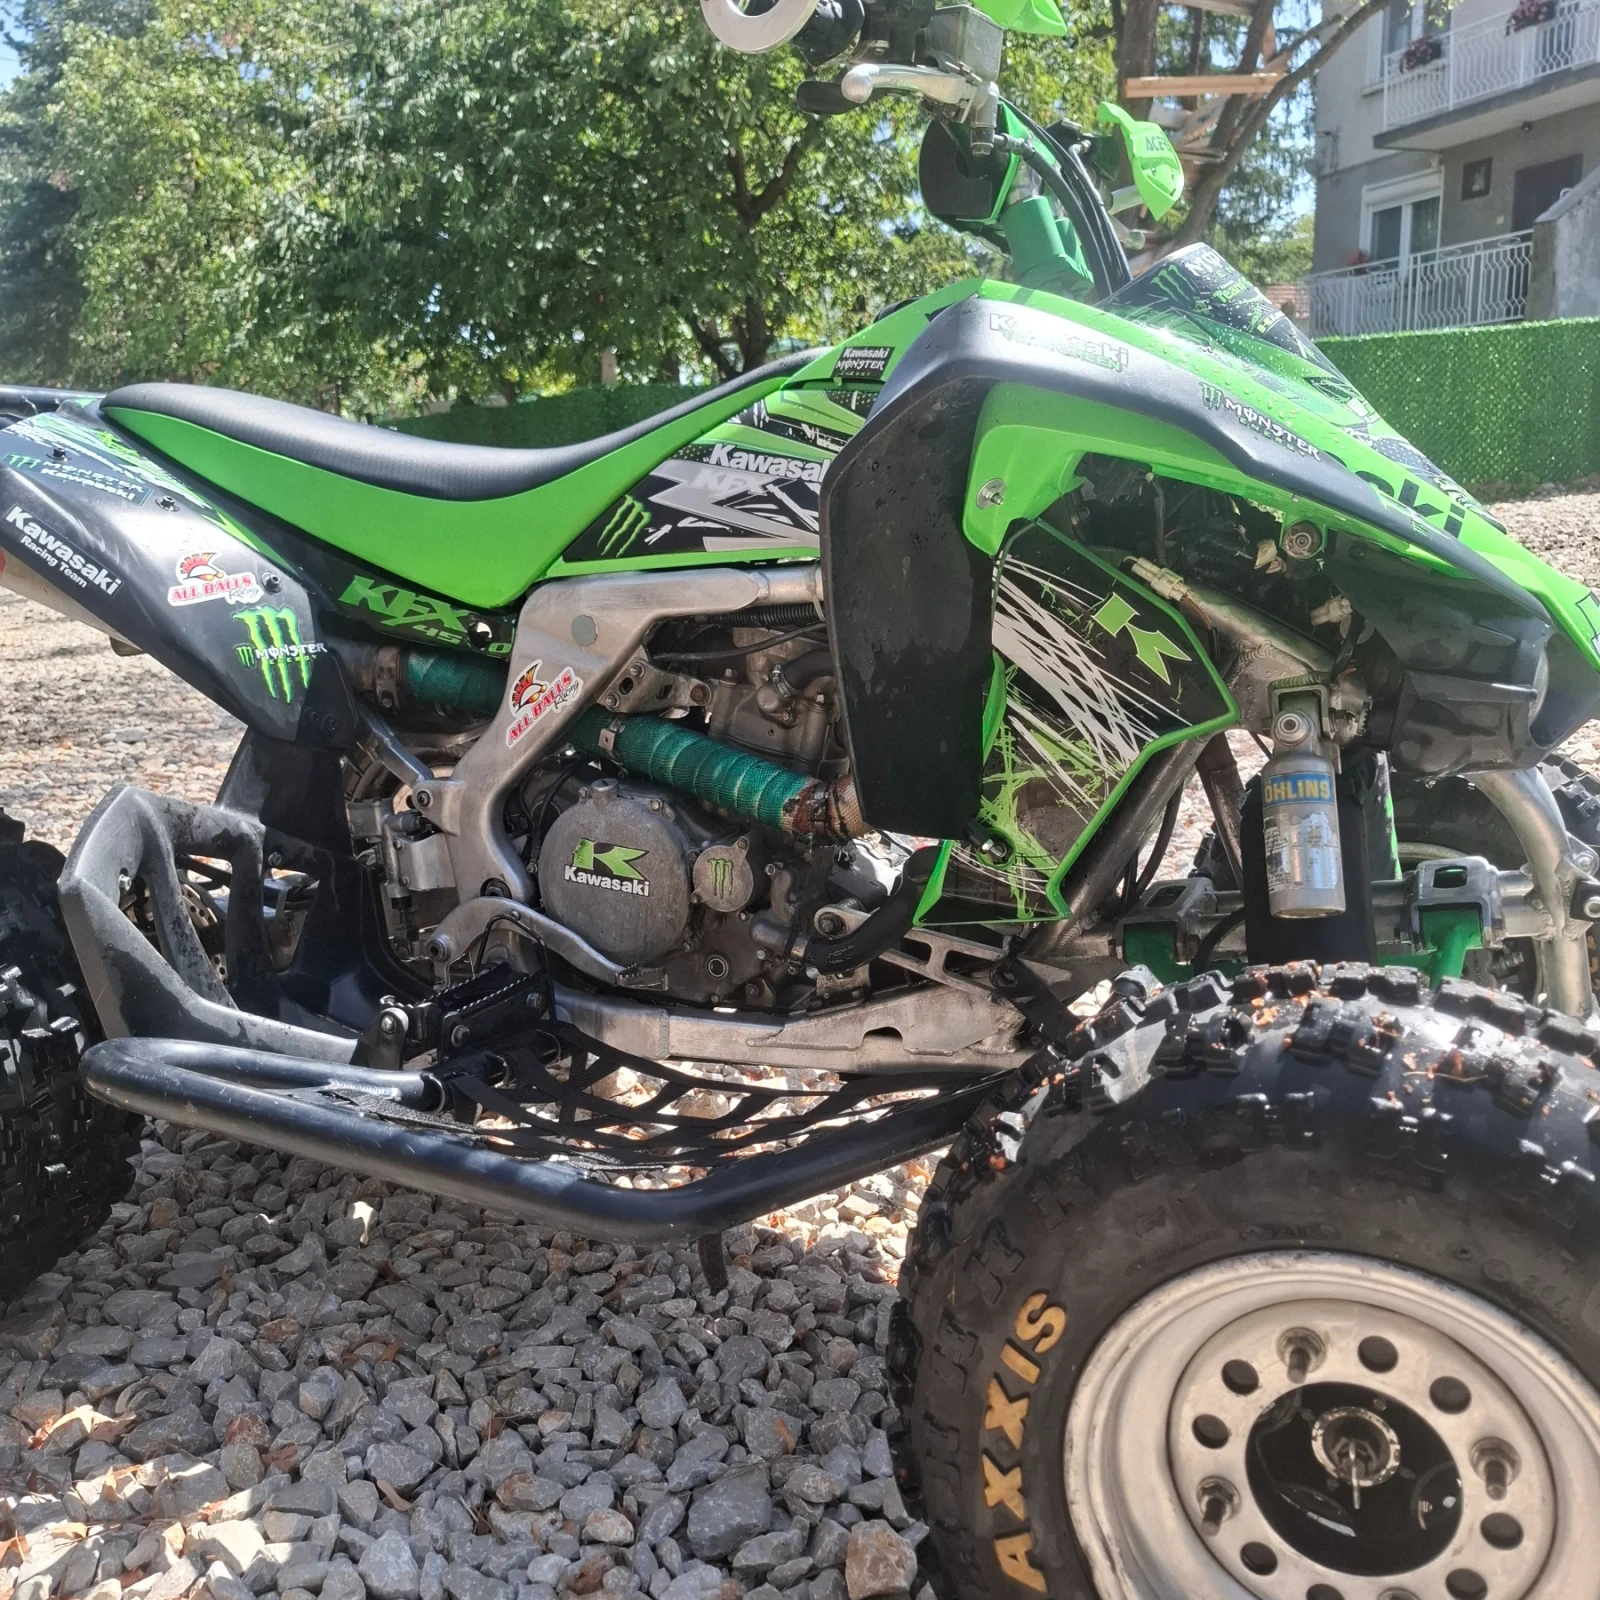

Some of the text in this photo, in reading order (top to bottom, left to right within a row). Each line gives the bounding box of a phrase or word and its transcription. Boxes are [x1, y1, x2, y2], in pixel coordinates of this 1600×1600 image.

[843, 347, 890, 358] Kawasaki
[1225, 398, 1321, 461] MONSTER
[5, 505, 122, 595] Kawasaki
[20, 535, 88, 588] Racing Team
[172, 574, 253, 602] ALL BALLS
[338, 575, 475, 633] KFX
[508, 669, 574, 746] ALL BALLS
[564, 865, 649, 897] Kawasaki
